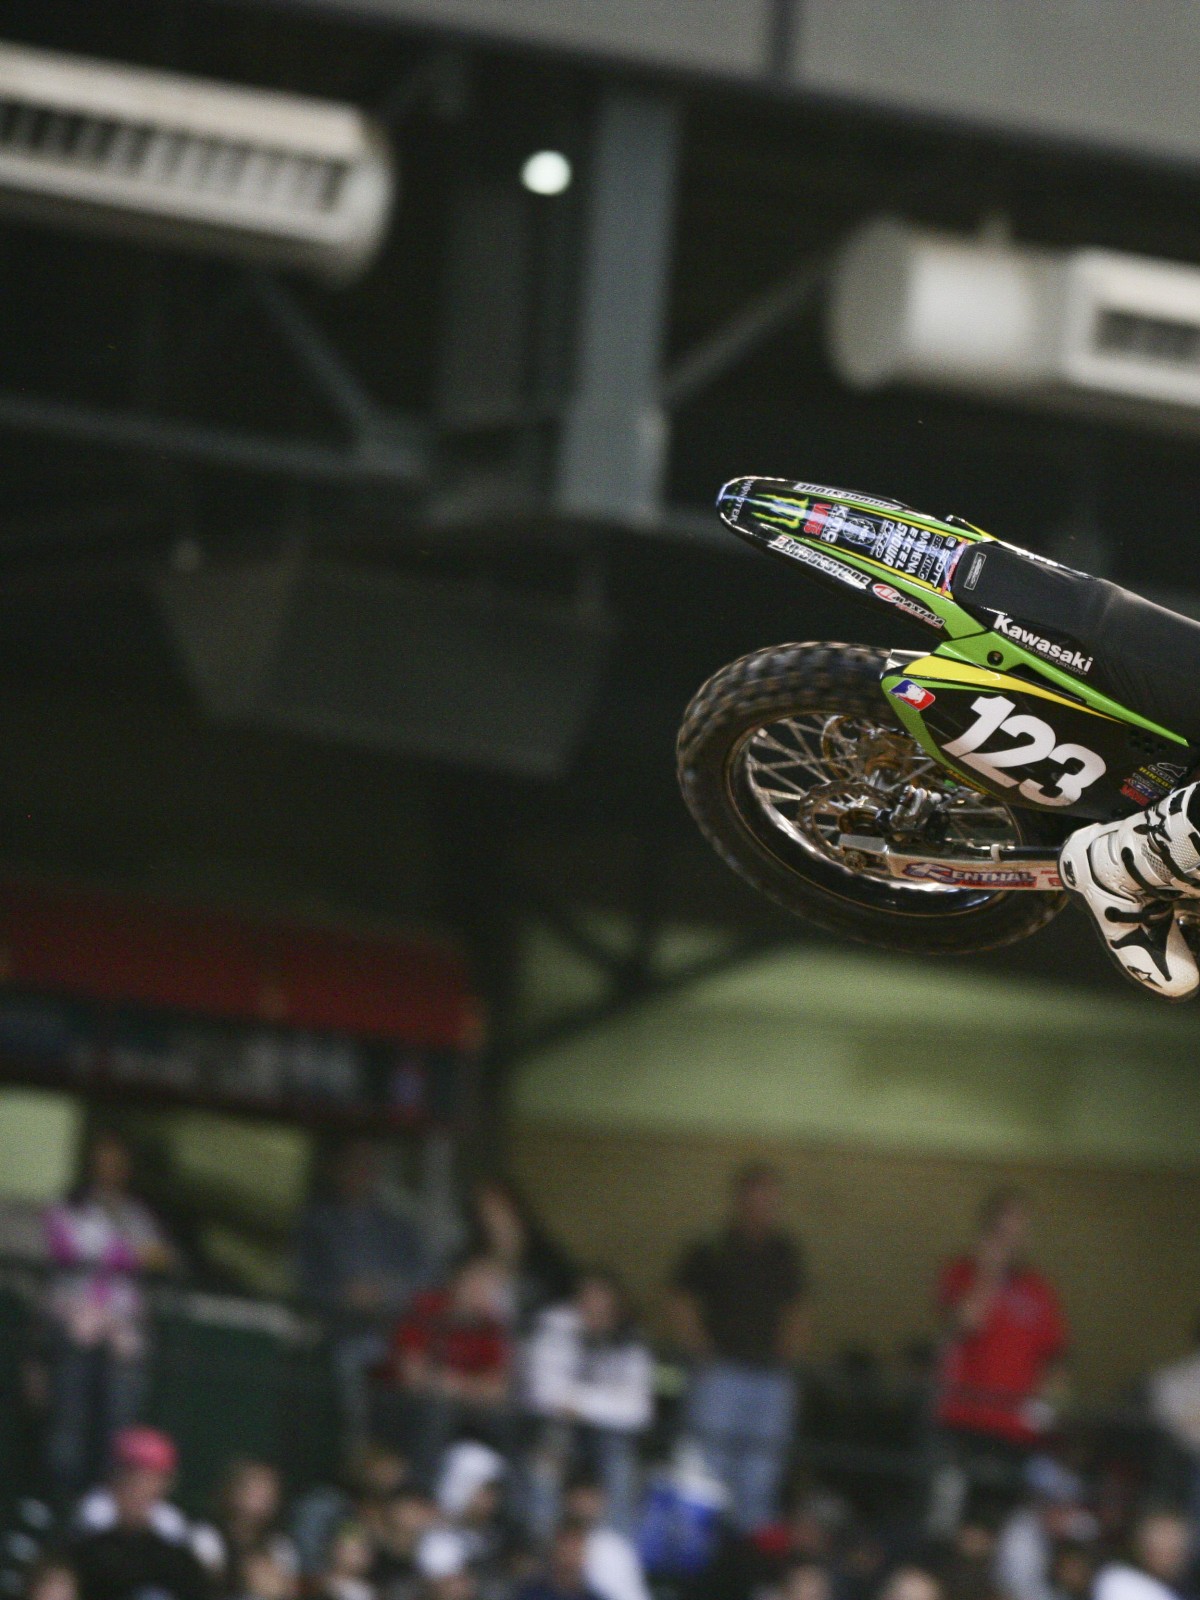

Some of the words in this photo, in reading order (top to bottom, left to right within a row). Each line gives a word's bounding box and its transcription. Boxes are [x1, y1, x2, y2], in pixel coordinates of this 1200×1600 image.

[882, 521, 908, 567] SHOWA
[895, 526, 919, 569] EXCEL
[905, 537, 927, 574] ATHENA
[930, 548, 951, 588] SCOTT
[993, 613, 1094, 673] Kawasaki
[941, 695, 1107, 806] 123
